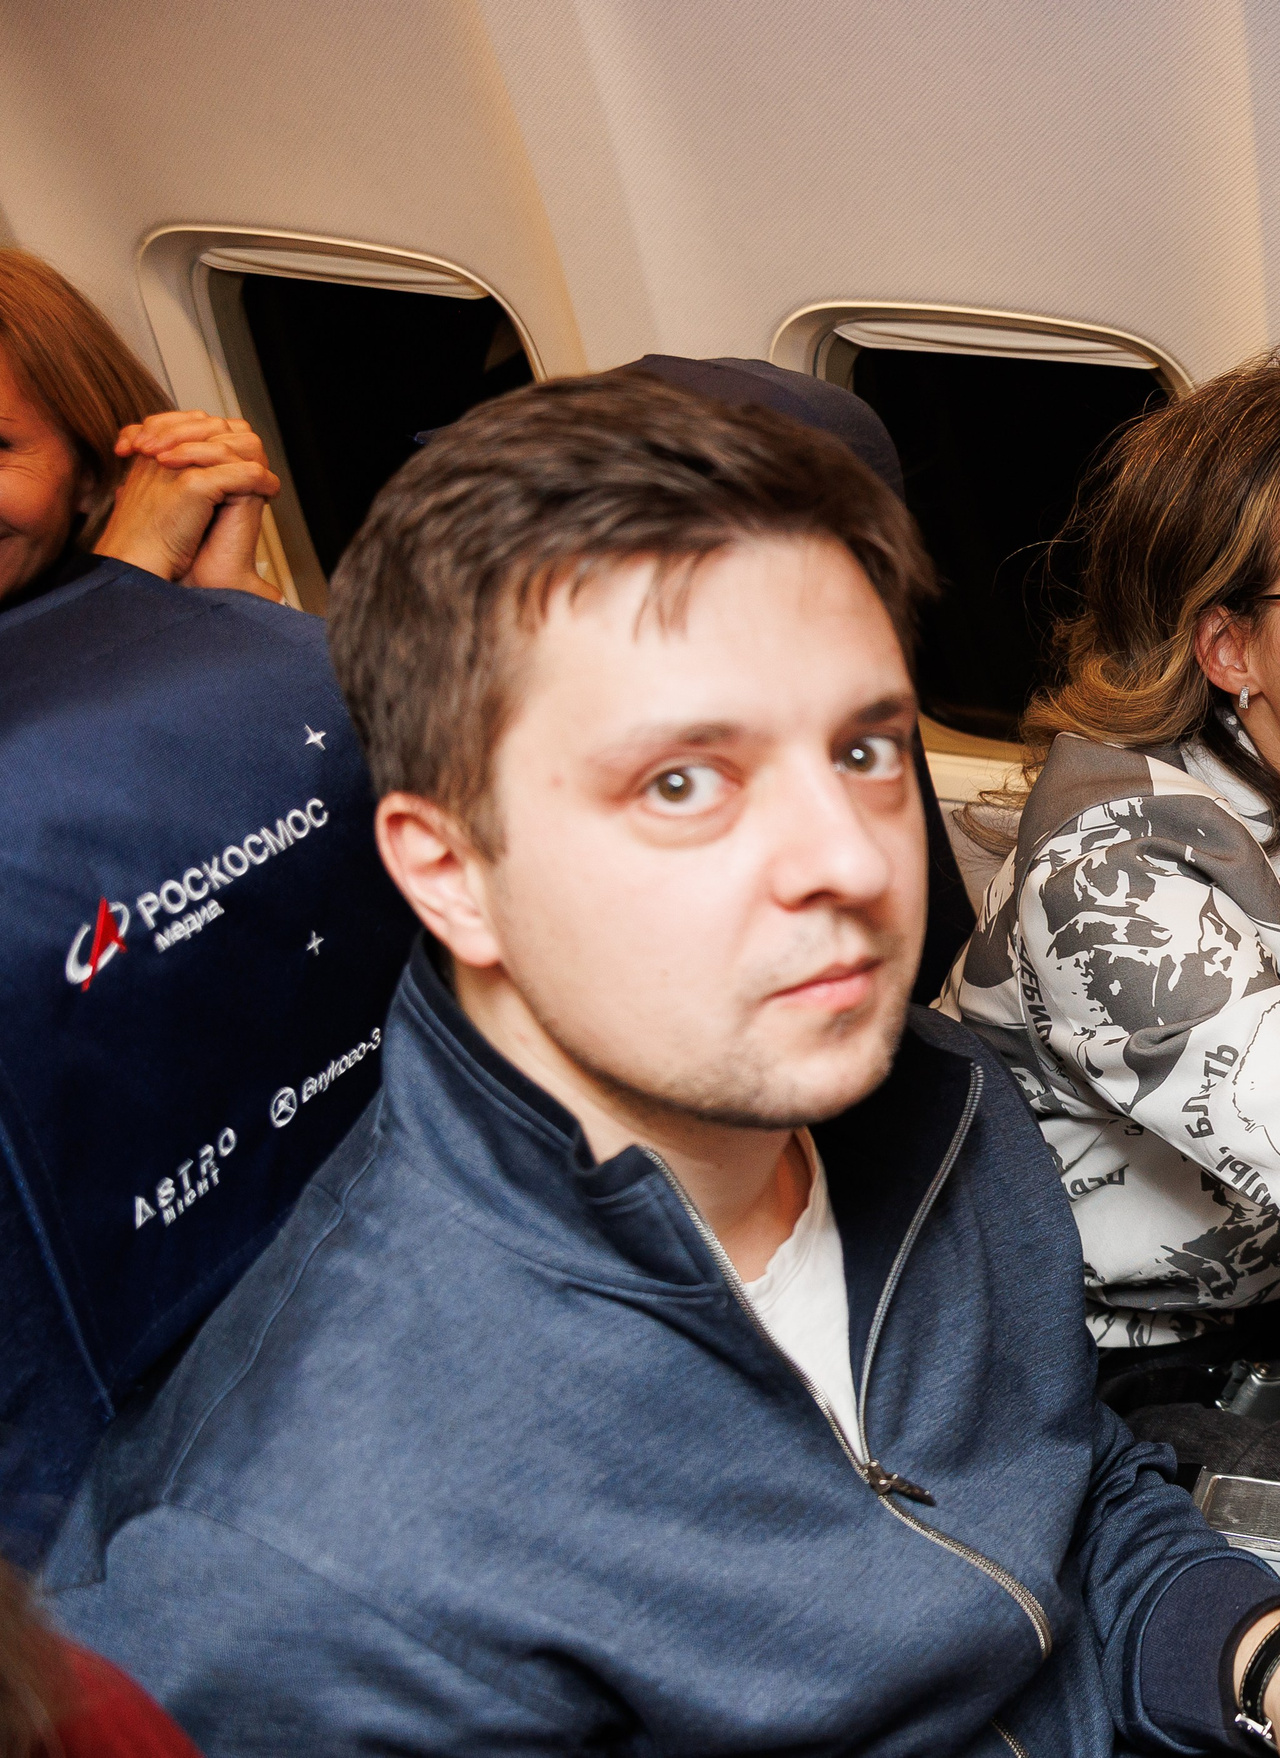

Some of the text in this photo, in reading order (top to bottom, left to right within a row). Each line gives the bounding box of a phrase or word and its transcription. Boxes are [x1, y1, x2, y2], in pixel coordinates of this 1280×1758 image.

[137, 798, 329, 930] РОСКОСМОС
[302, 1027, 382, 1104] Внуково-3
[134, 1126, 238, 1230] ASTRO
